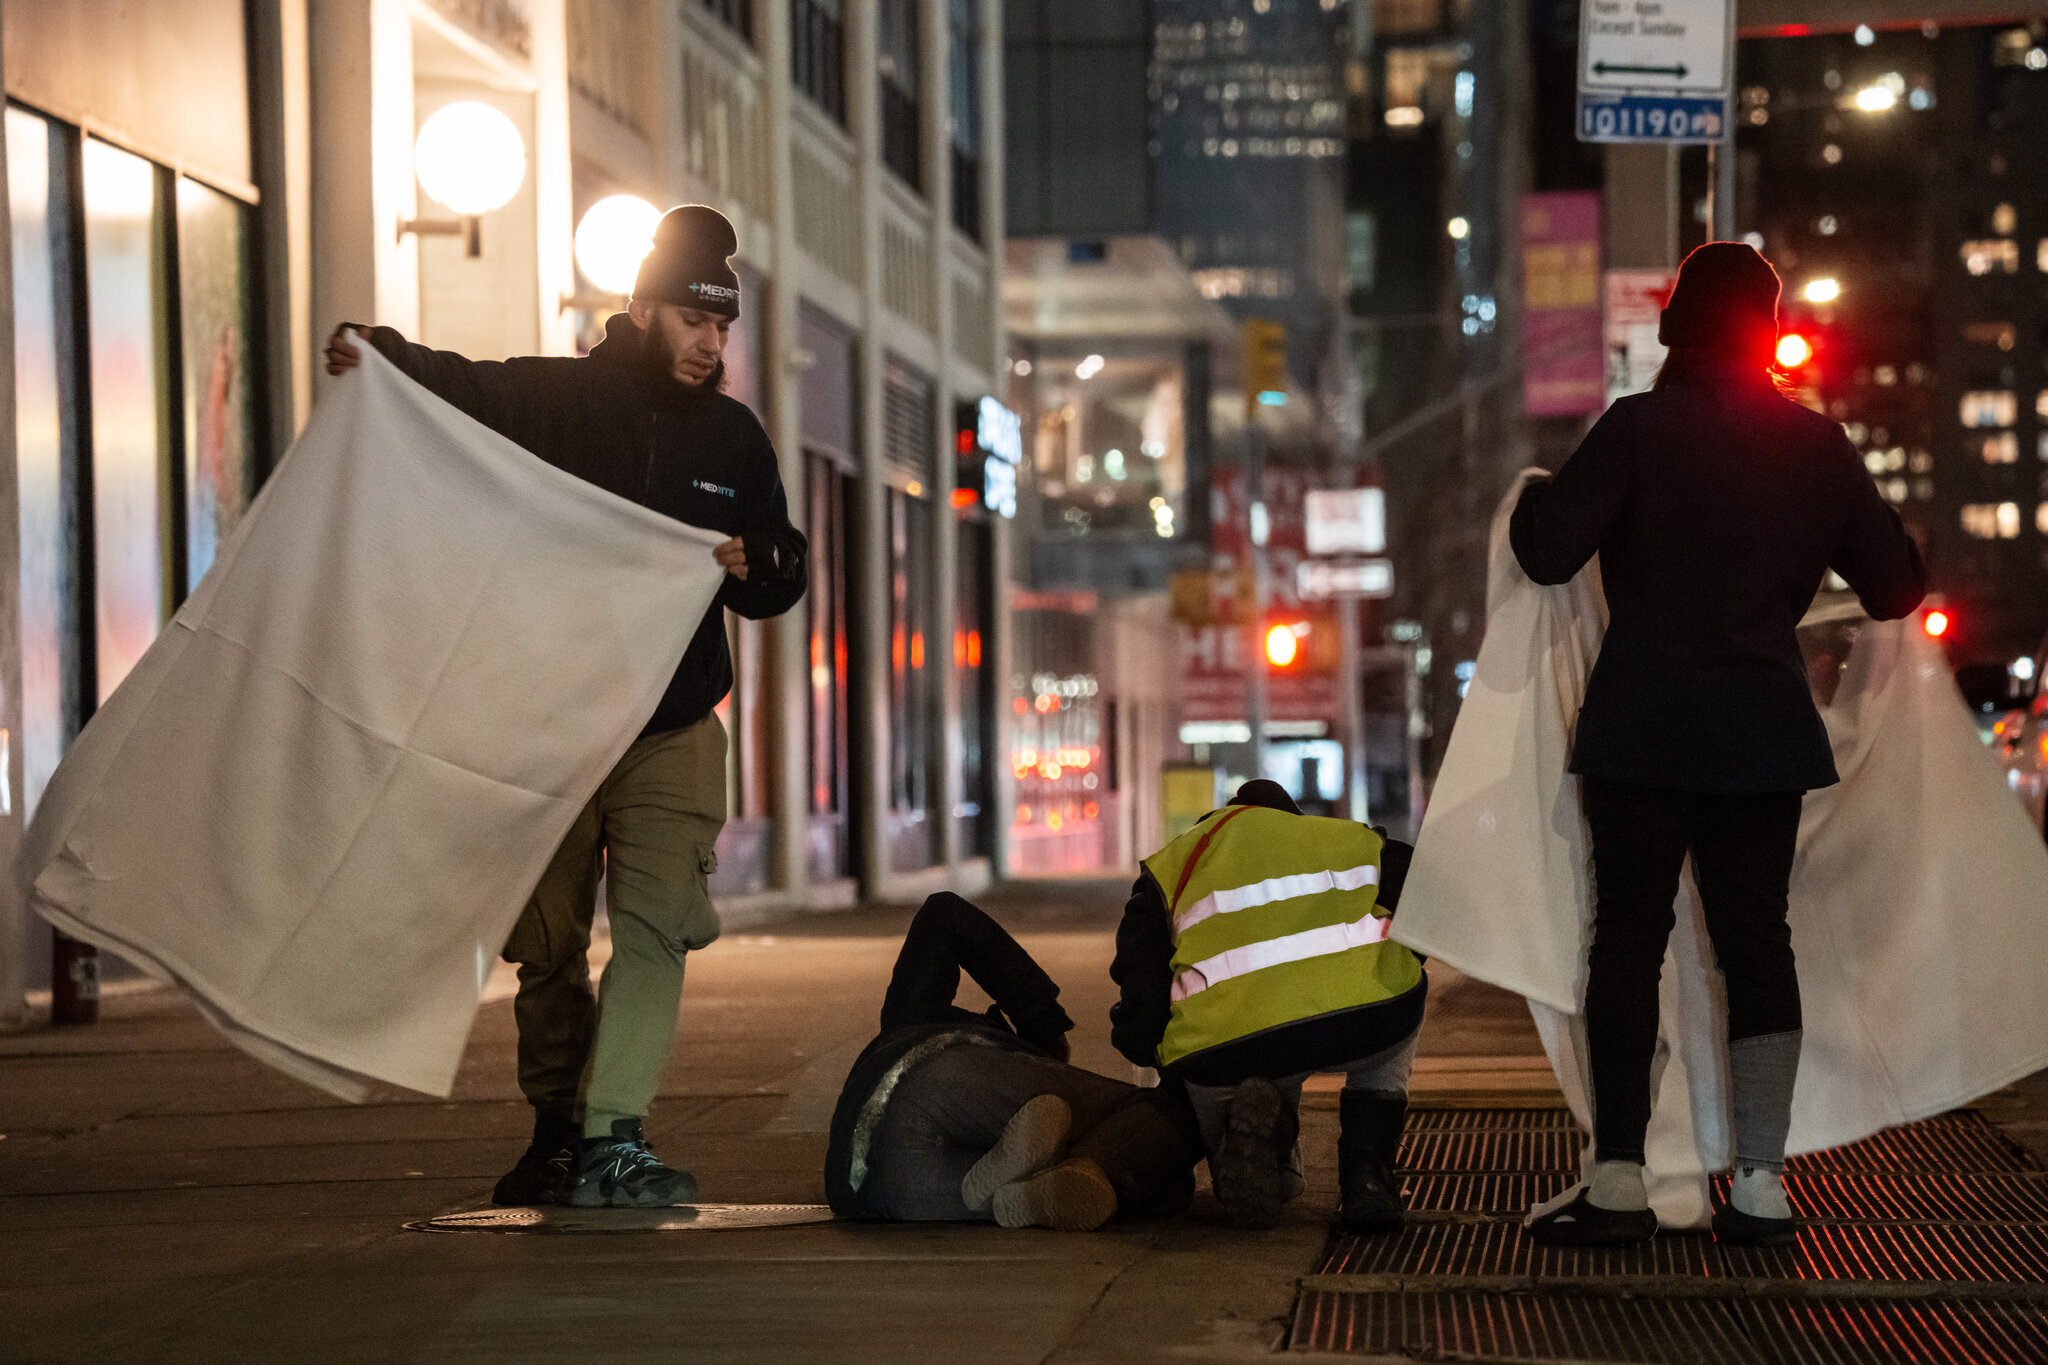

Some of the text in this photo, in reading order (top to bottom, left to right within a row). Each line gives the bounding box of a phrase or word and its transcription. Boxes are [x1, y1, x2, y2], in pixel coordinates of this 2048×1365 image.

[1584, 107, 1688, 136] 101190
[700, 282, 740, 301] MEDRIT
[700, 481, 735, 498] MEDRITE
